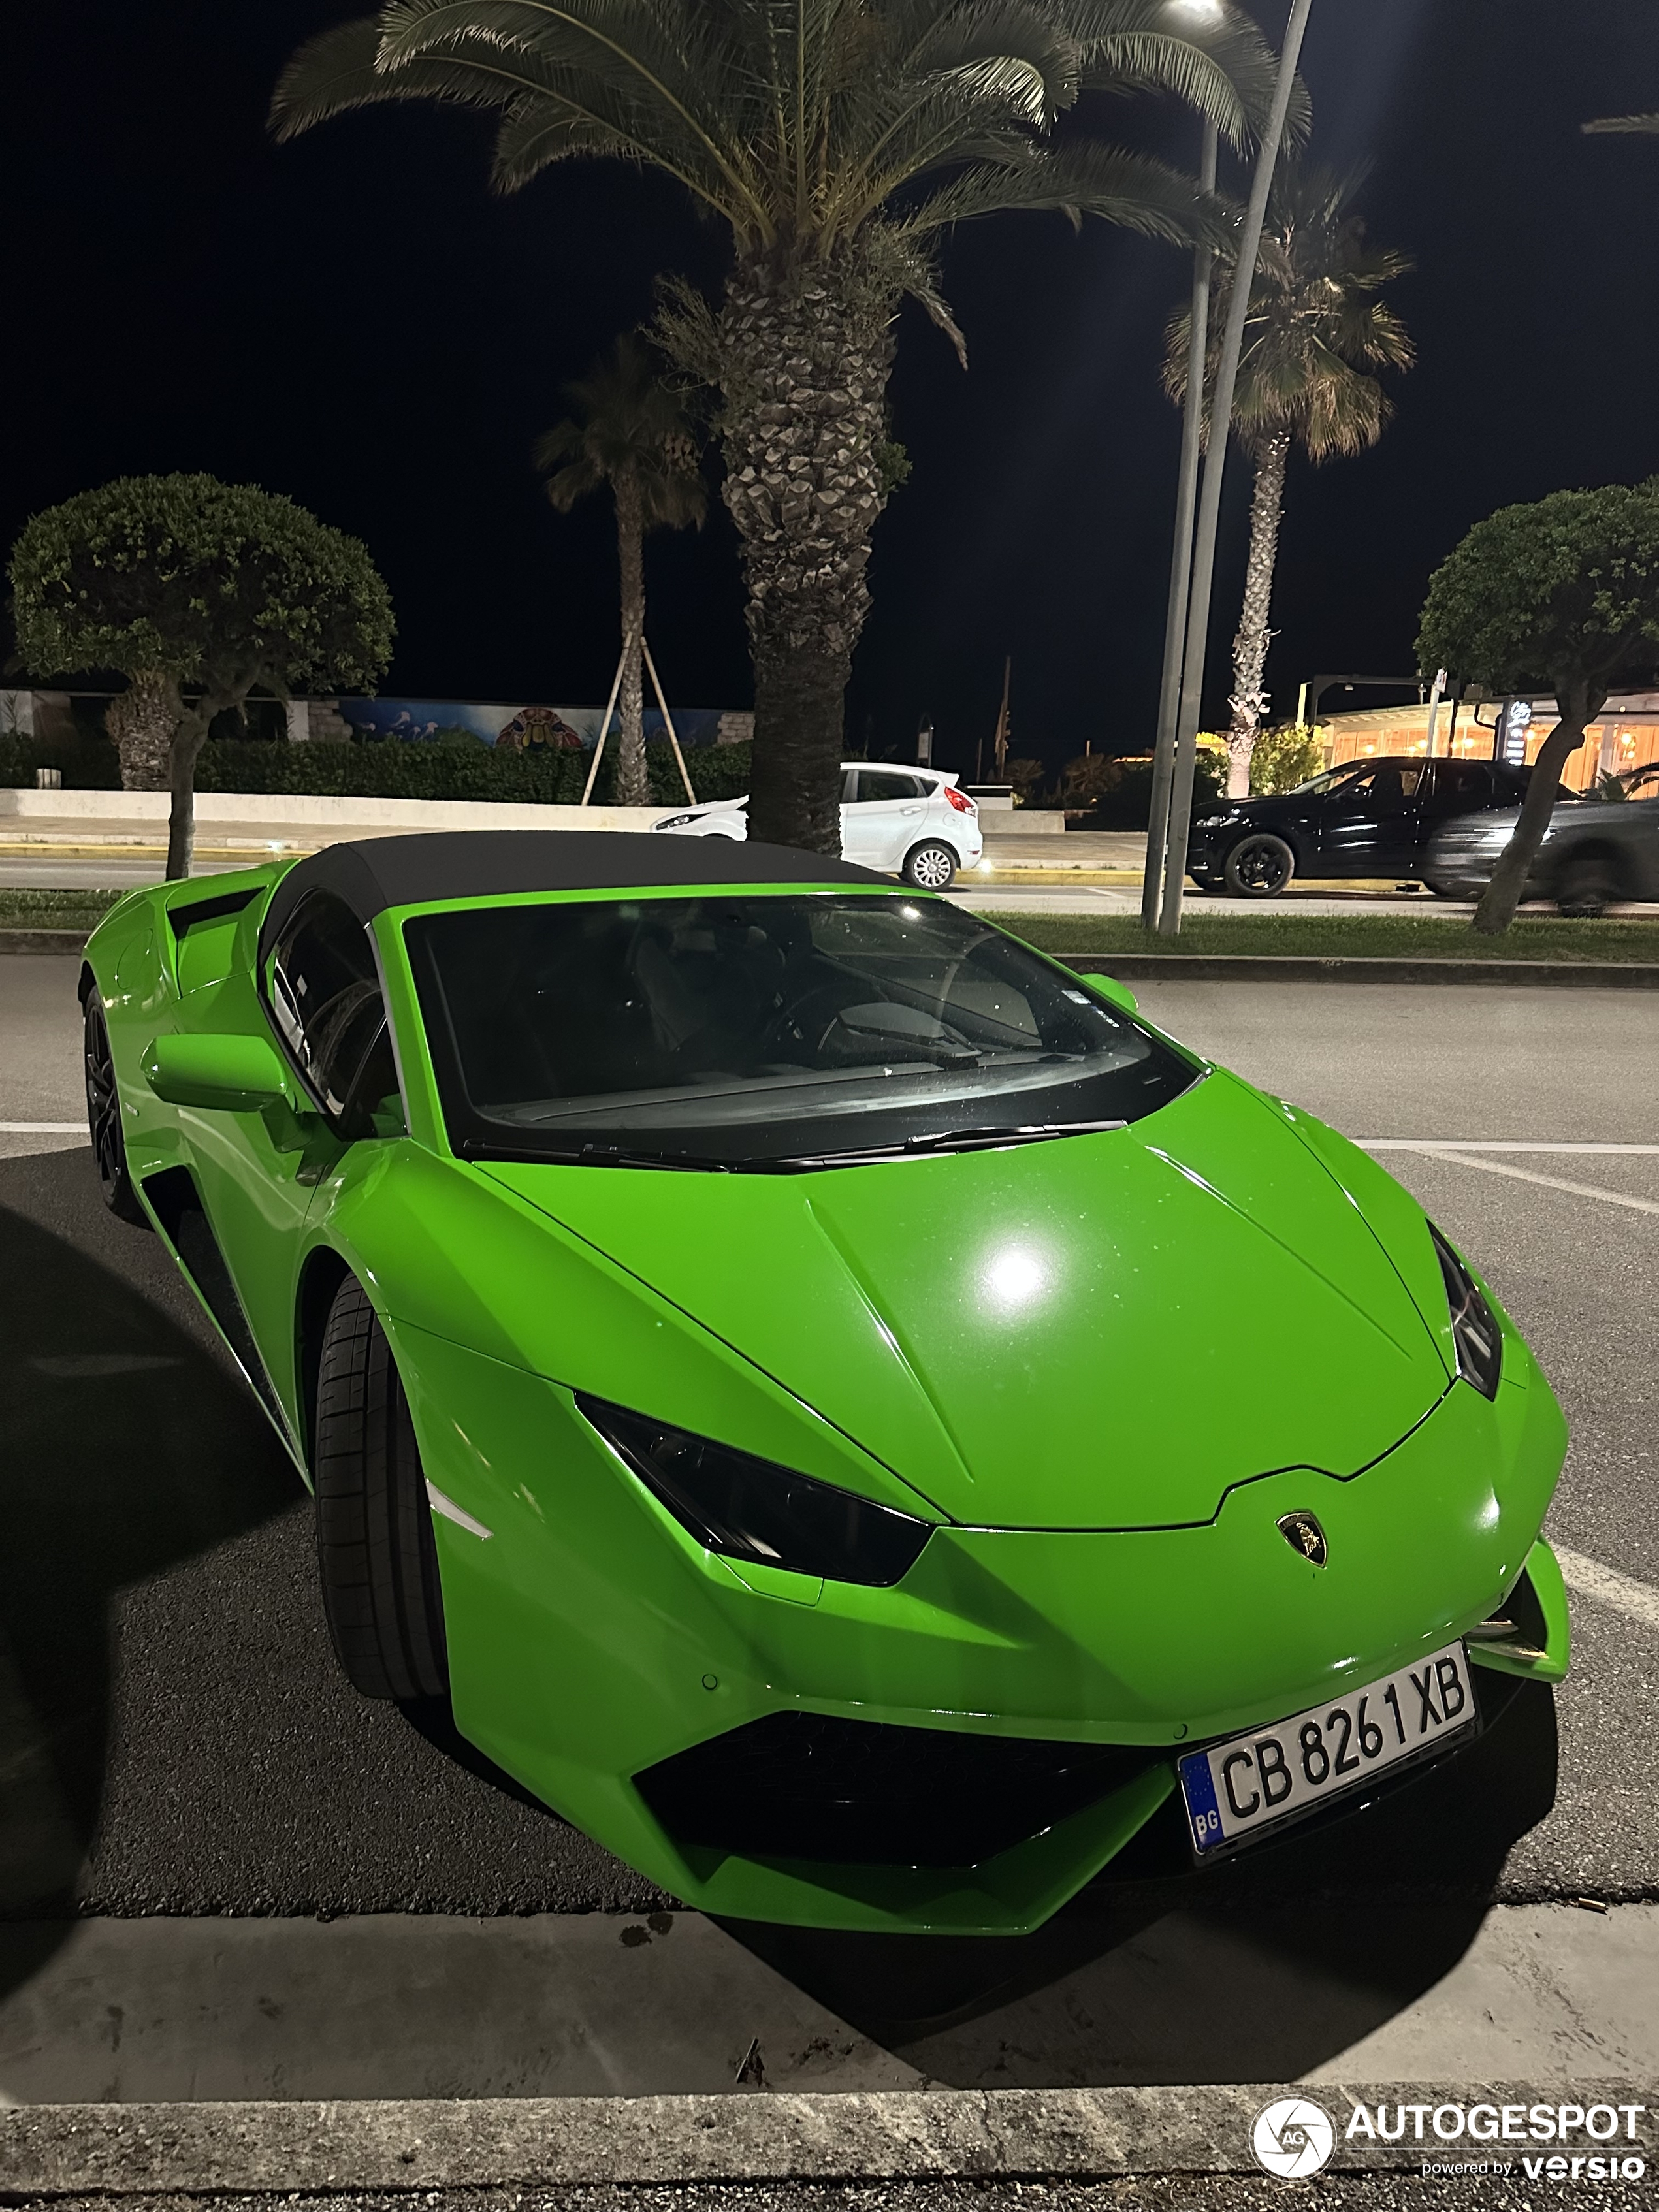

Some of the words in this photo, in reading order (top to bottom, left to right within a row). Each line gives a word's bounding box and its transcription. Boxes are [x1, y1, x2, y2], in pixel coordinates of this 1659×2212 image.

[1223, 1739, 1293, 1818] CB
[1299, 1683, 1406, 1785] 8261
[1410, 1658, 1465, 1733] XB
[1195, 1810, 1219, 1836] BG
